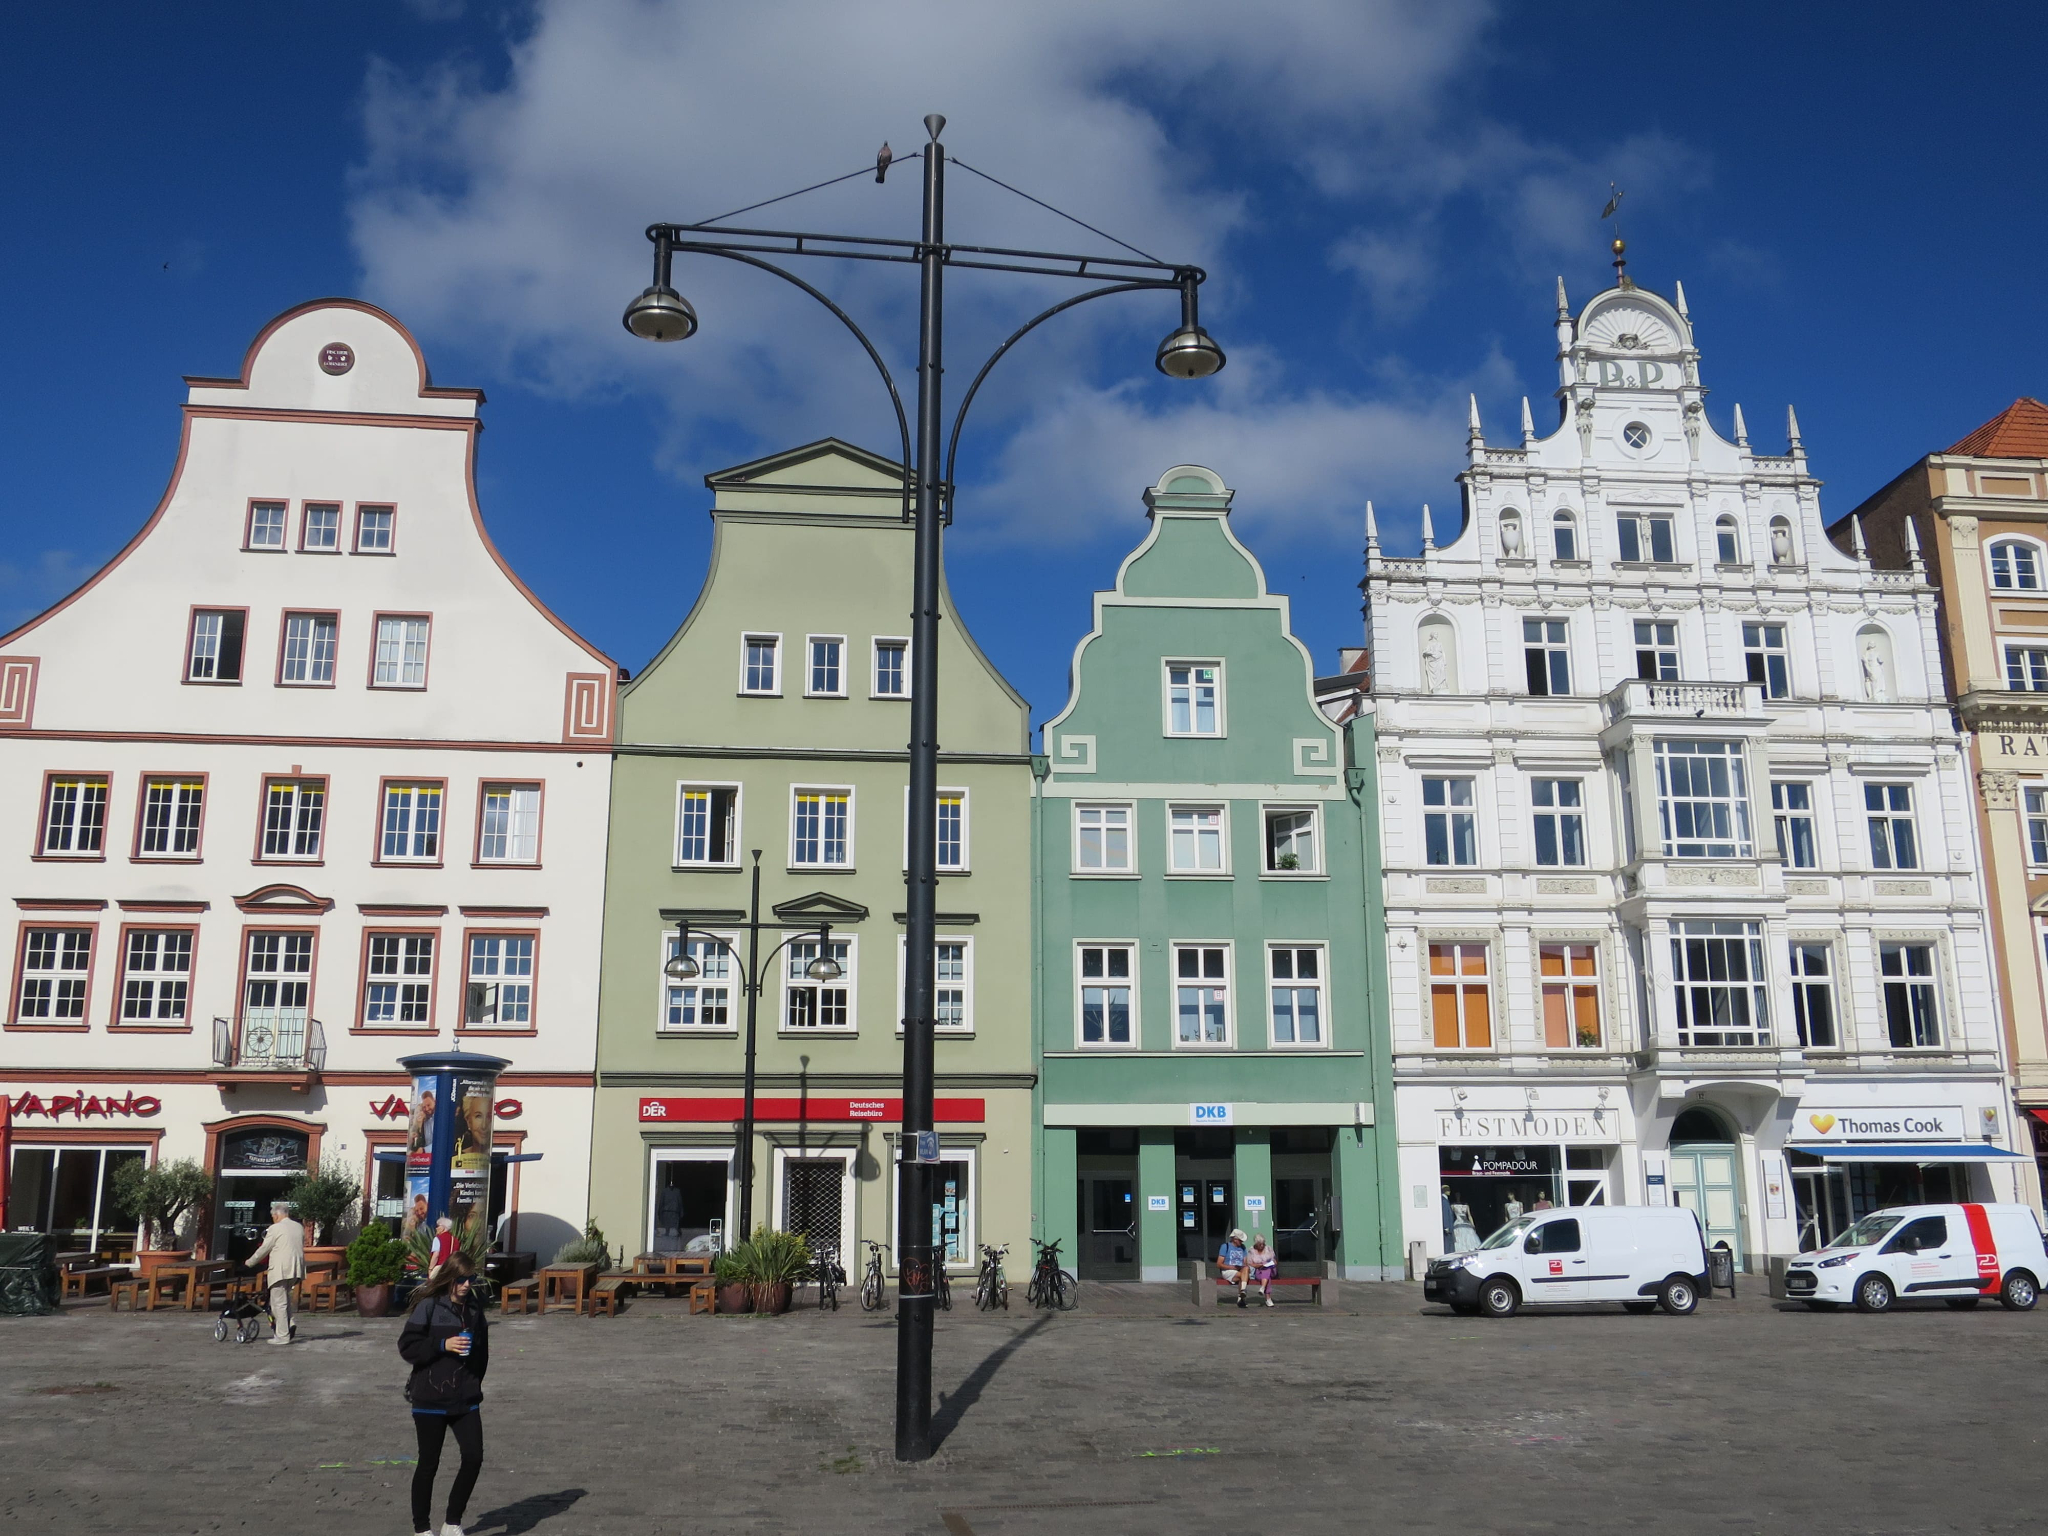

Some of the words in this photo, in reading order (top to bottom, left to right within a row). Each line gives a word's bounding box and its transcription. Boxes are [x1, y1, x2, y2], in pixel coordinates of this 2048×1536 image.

[643, 1102, 666, 1117] DER
[1196, 1106, 1226, 1118] DKB
[1441, 1117, 1607, 1137] FESTMODEN
[1838, 1118, 1900, 1133] Thomas
[1904, 1117, 1943, 1133] Cook
[1483, 1161, 1538, 1170] POMPADOUR
